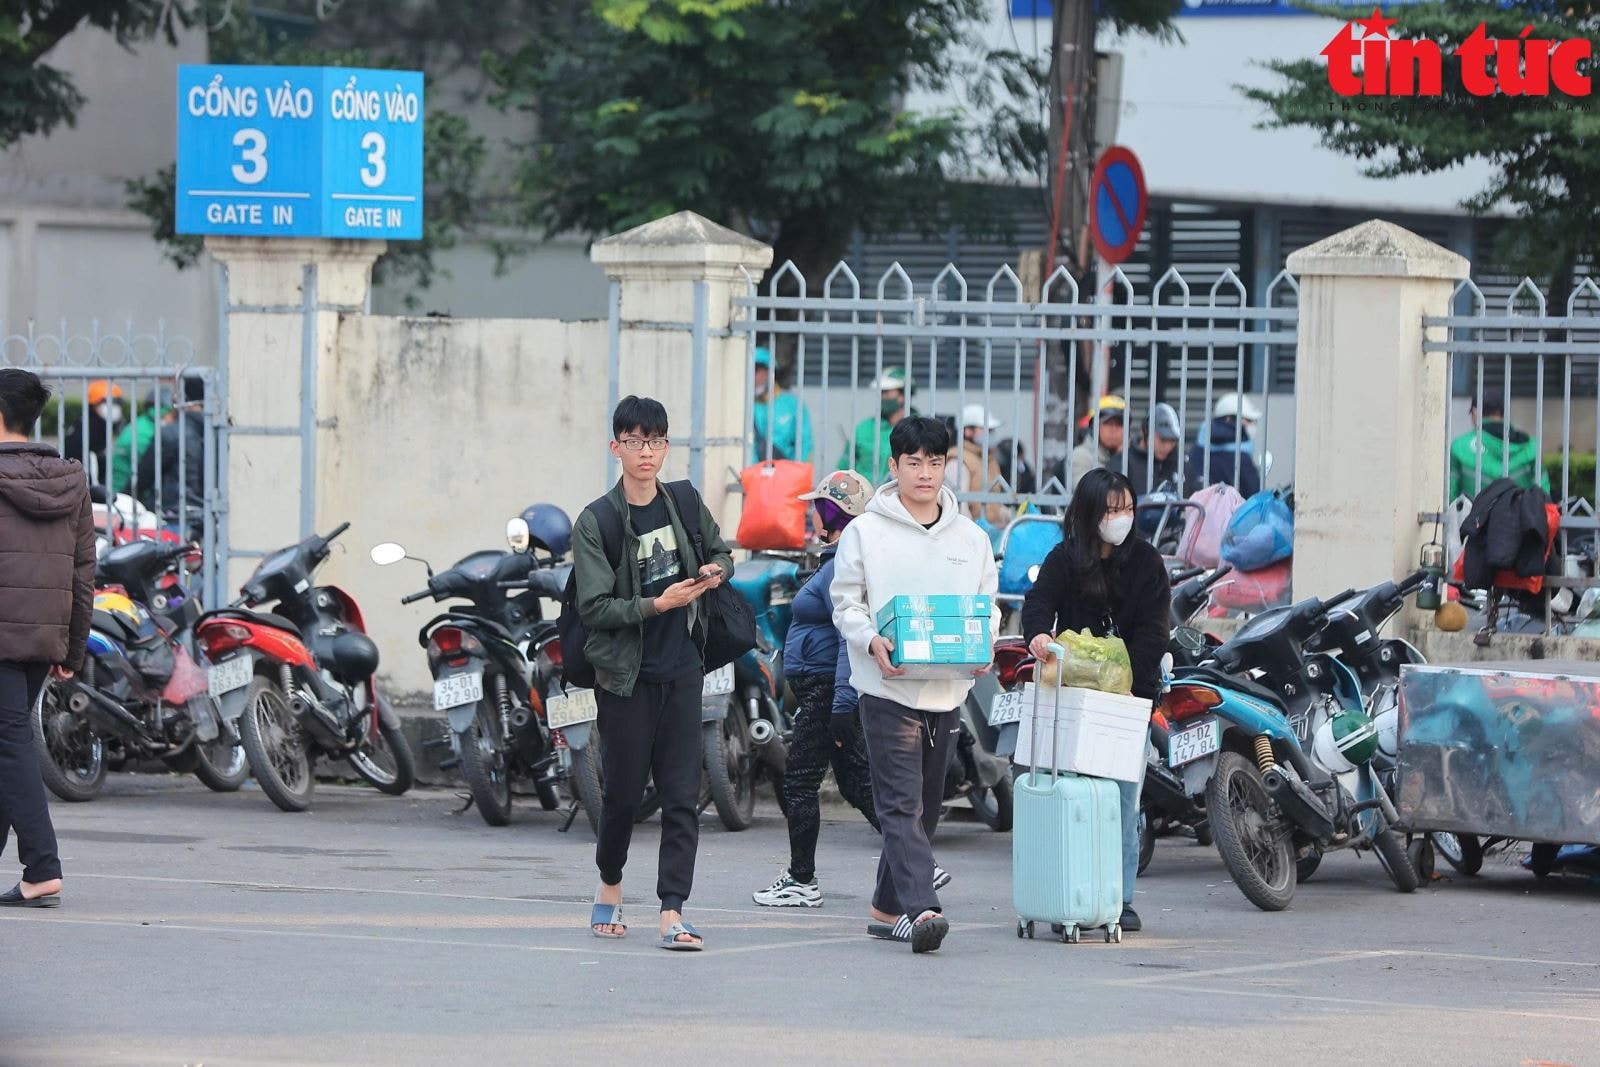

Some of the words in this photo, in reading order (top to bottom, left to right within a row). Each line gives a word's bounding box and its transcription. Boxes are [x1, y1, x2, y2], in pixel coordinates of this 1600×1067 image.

[188, 73, 258, 118] CỔNG
[265, 80, 313, 118] VÀO
[330, 76, 380, 121] CỔNG
[384, 84, 418, 123] VÀO
[231, 128, 268, 184] 3
[360, 131, 386, 188] 3
[207, 202, 262, 225] GATE
[273, 205, 293, 225] IN
[345, 206, 383, 228] GATE
[387, 208, 401, 228] IN
[438, 686, 479, 706] 422.90
[1173, 737, 1216, 763] 147.84
